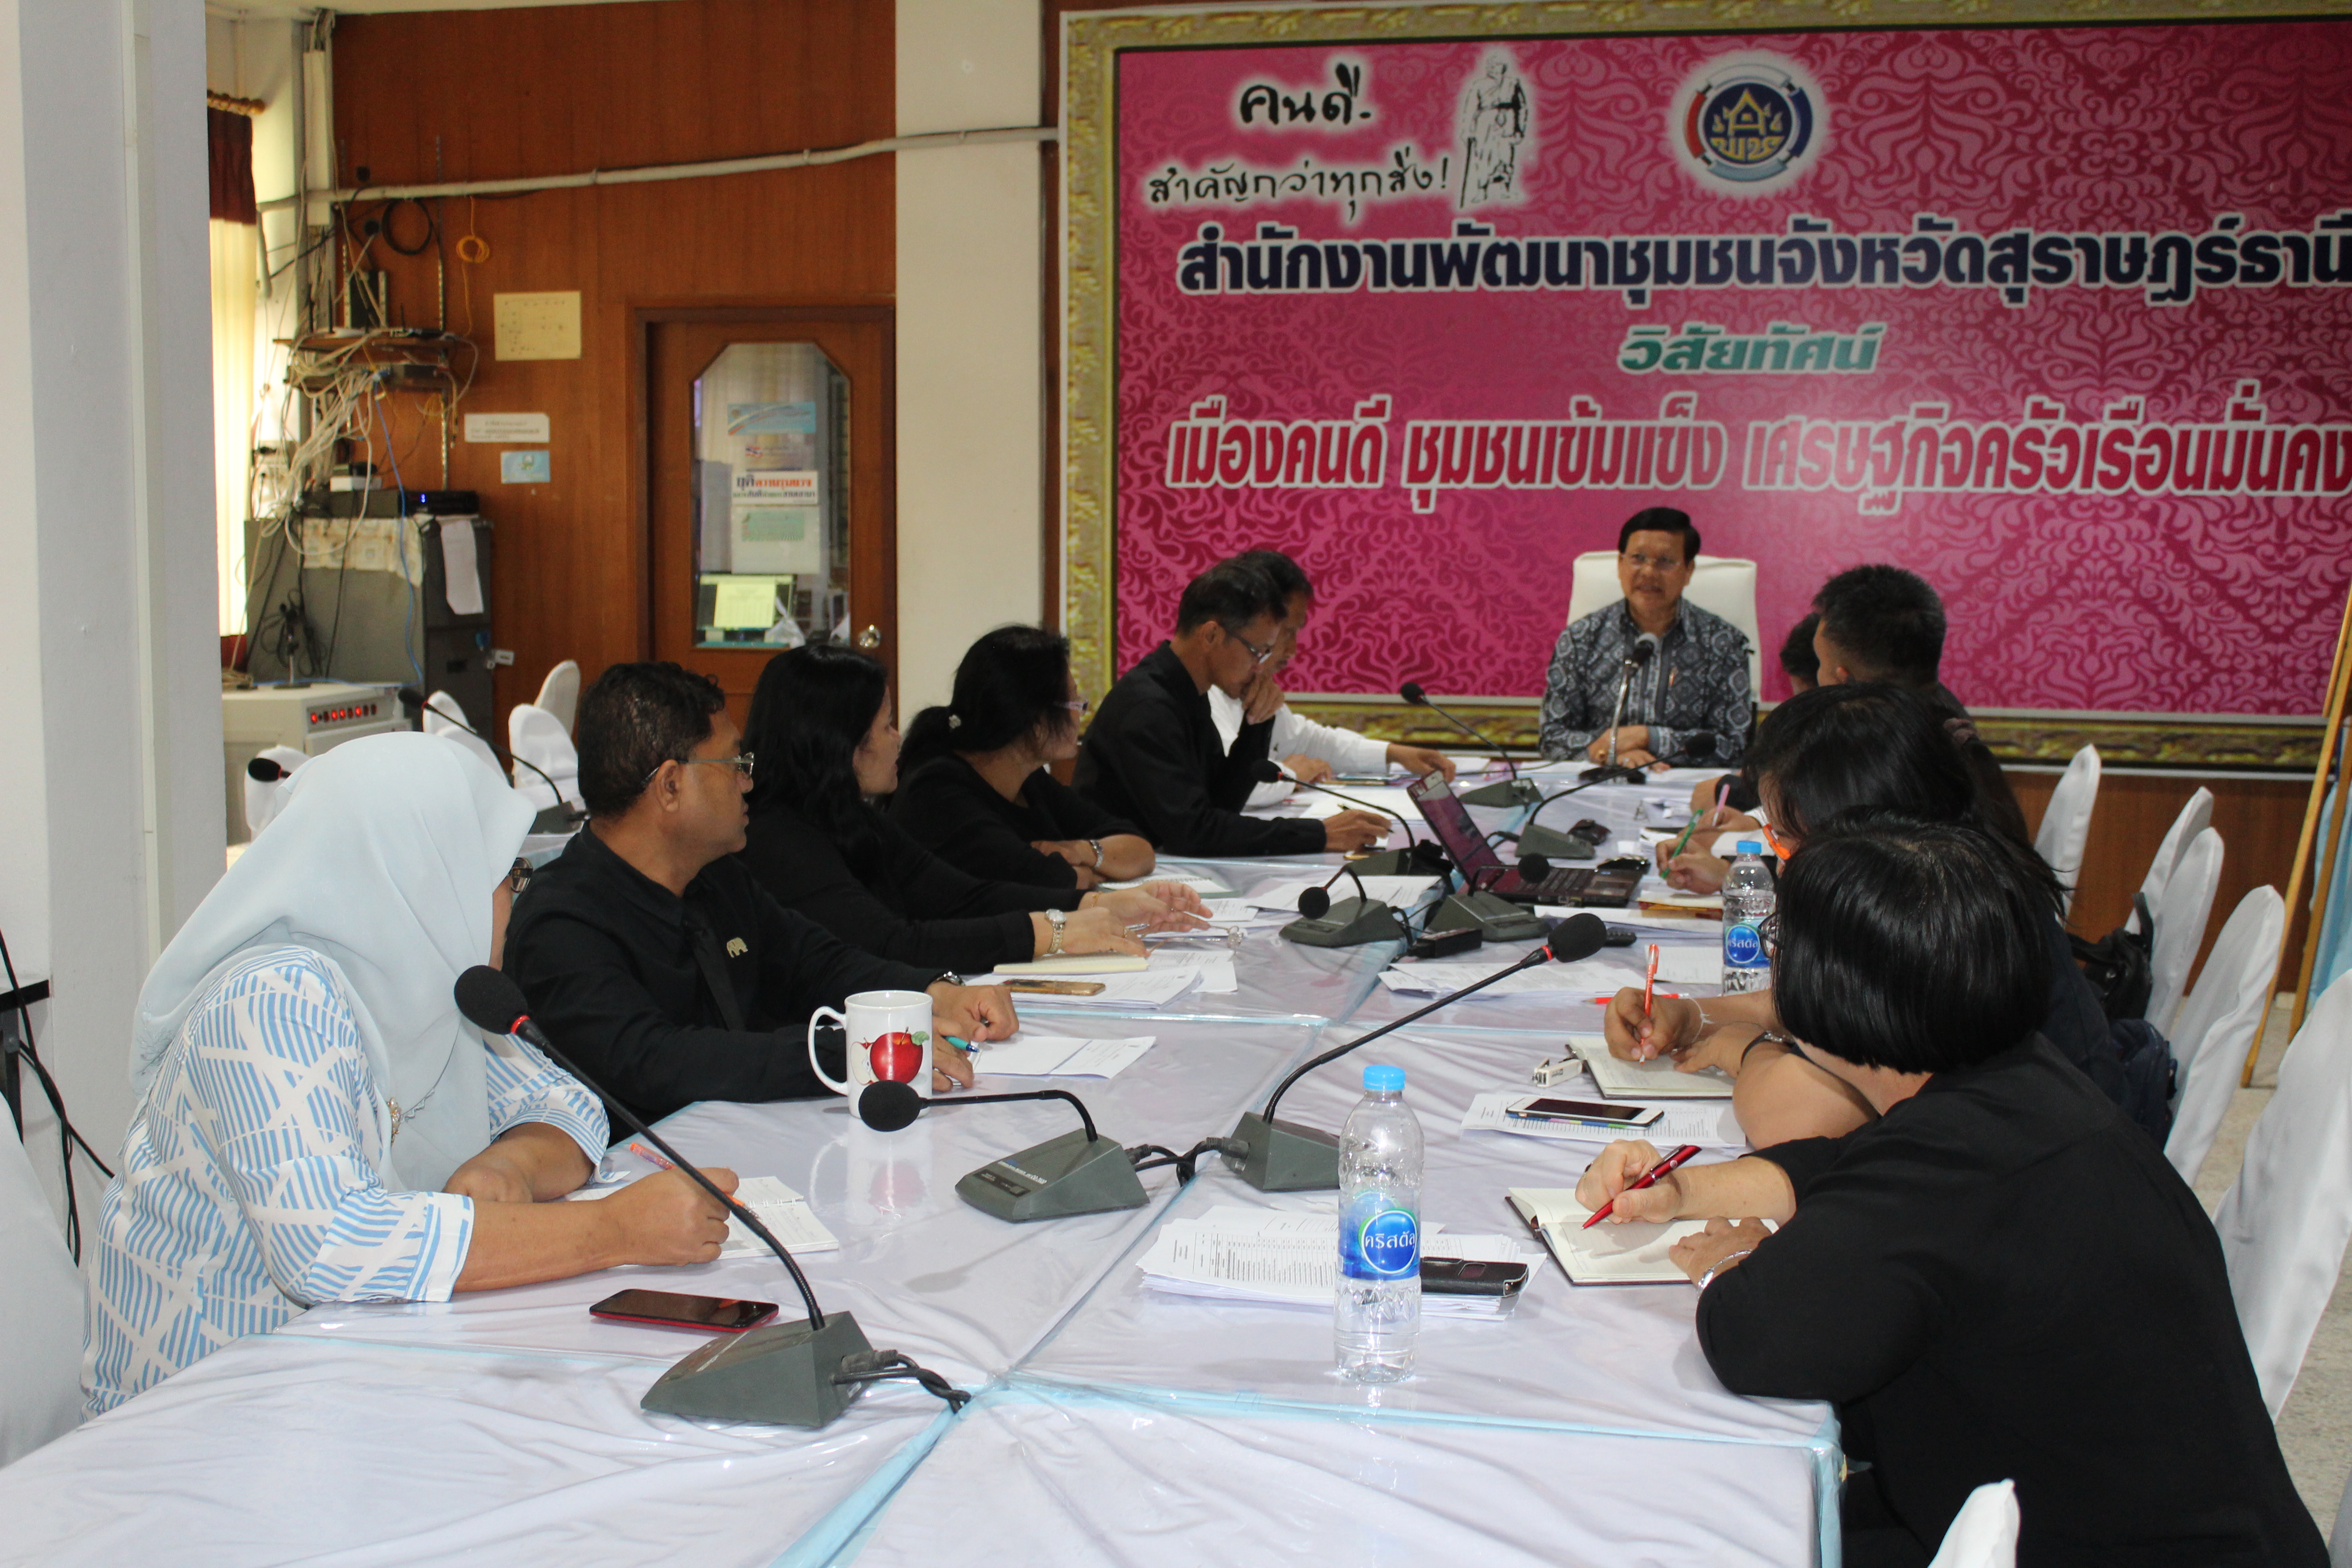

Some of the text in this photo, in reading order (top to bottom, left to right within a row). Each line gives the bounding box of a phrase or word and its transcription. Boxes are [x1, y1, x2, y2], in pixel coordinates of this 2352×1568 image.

[1622, 326, 1883, 370] วิสัยทัศน์
[1171, 399, 1388, 484] เมืองคนดี
[1407, 397, 1723, 509] ชุมชนเข้มแข็ง
[1365, 1230, 1415, 1249] คริสตัล
